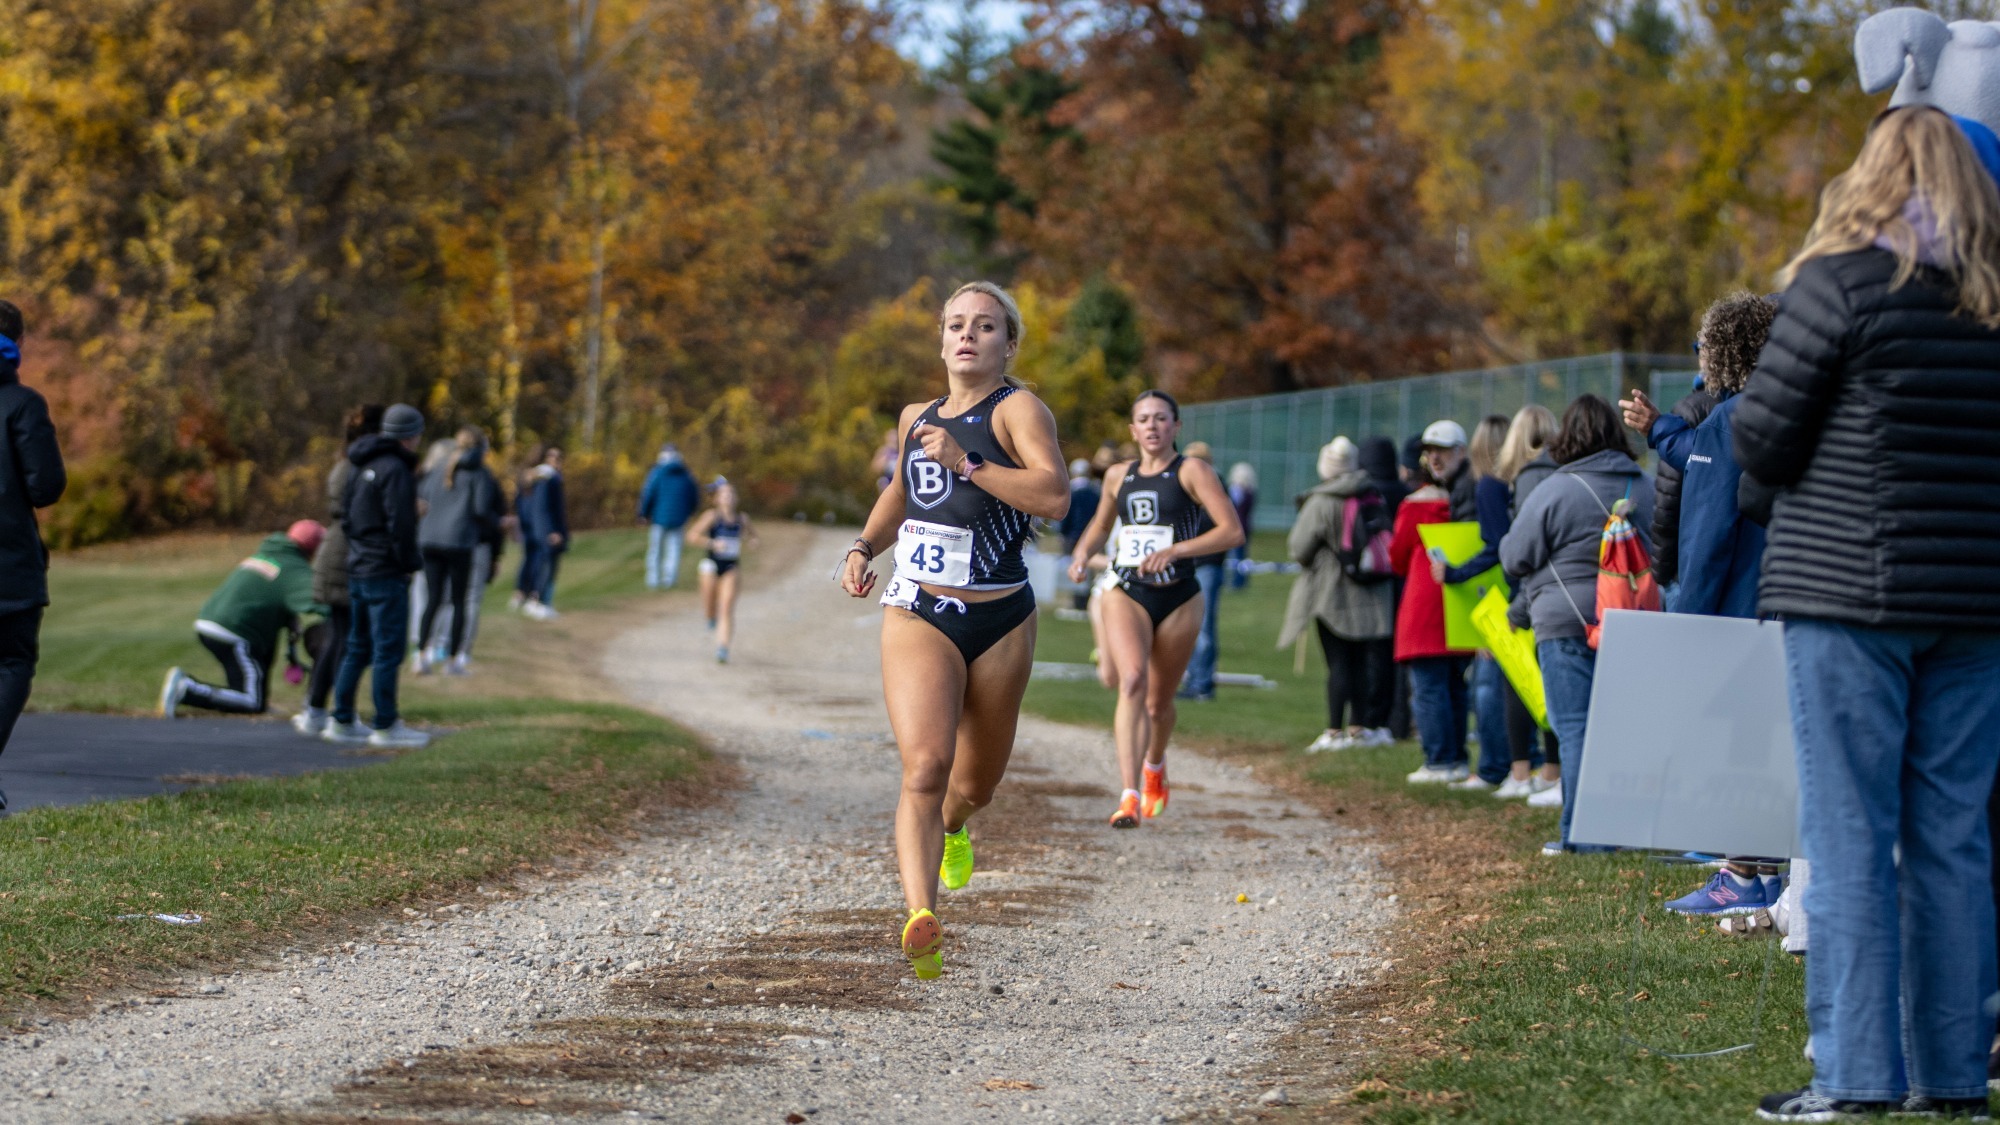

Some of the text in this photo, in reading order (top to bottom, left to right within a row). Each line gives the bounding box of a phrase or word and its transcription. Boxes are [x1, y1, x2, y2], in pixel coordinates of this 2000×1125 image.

[914, 462, 944, 494] B
[1132, 499, 1154, 523] B
[904, 524, 926, 536] NE10
[910, 542, 946, 574] 43
[1130, 539, 1156, 558] 36
